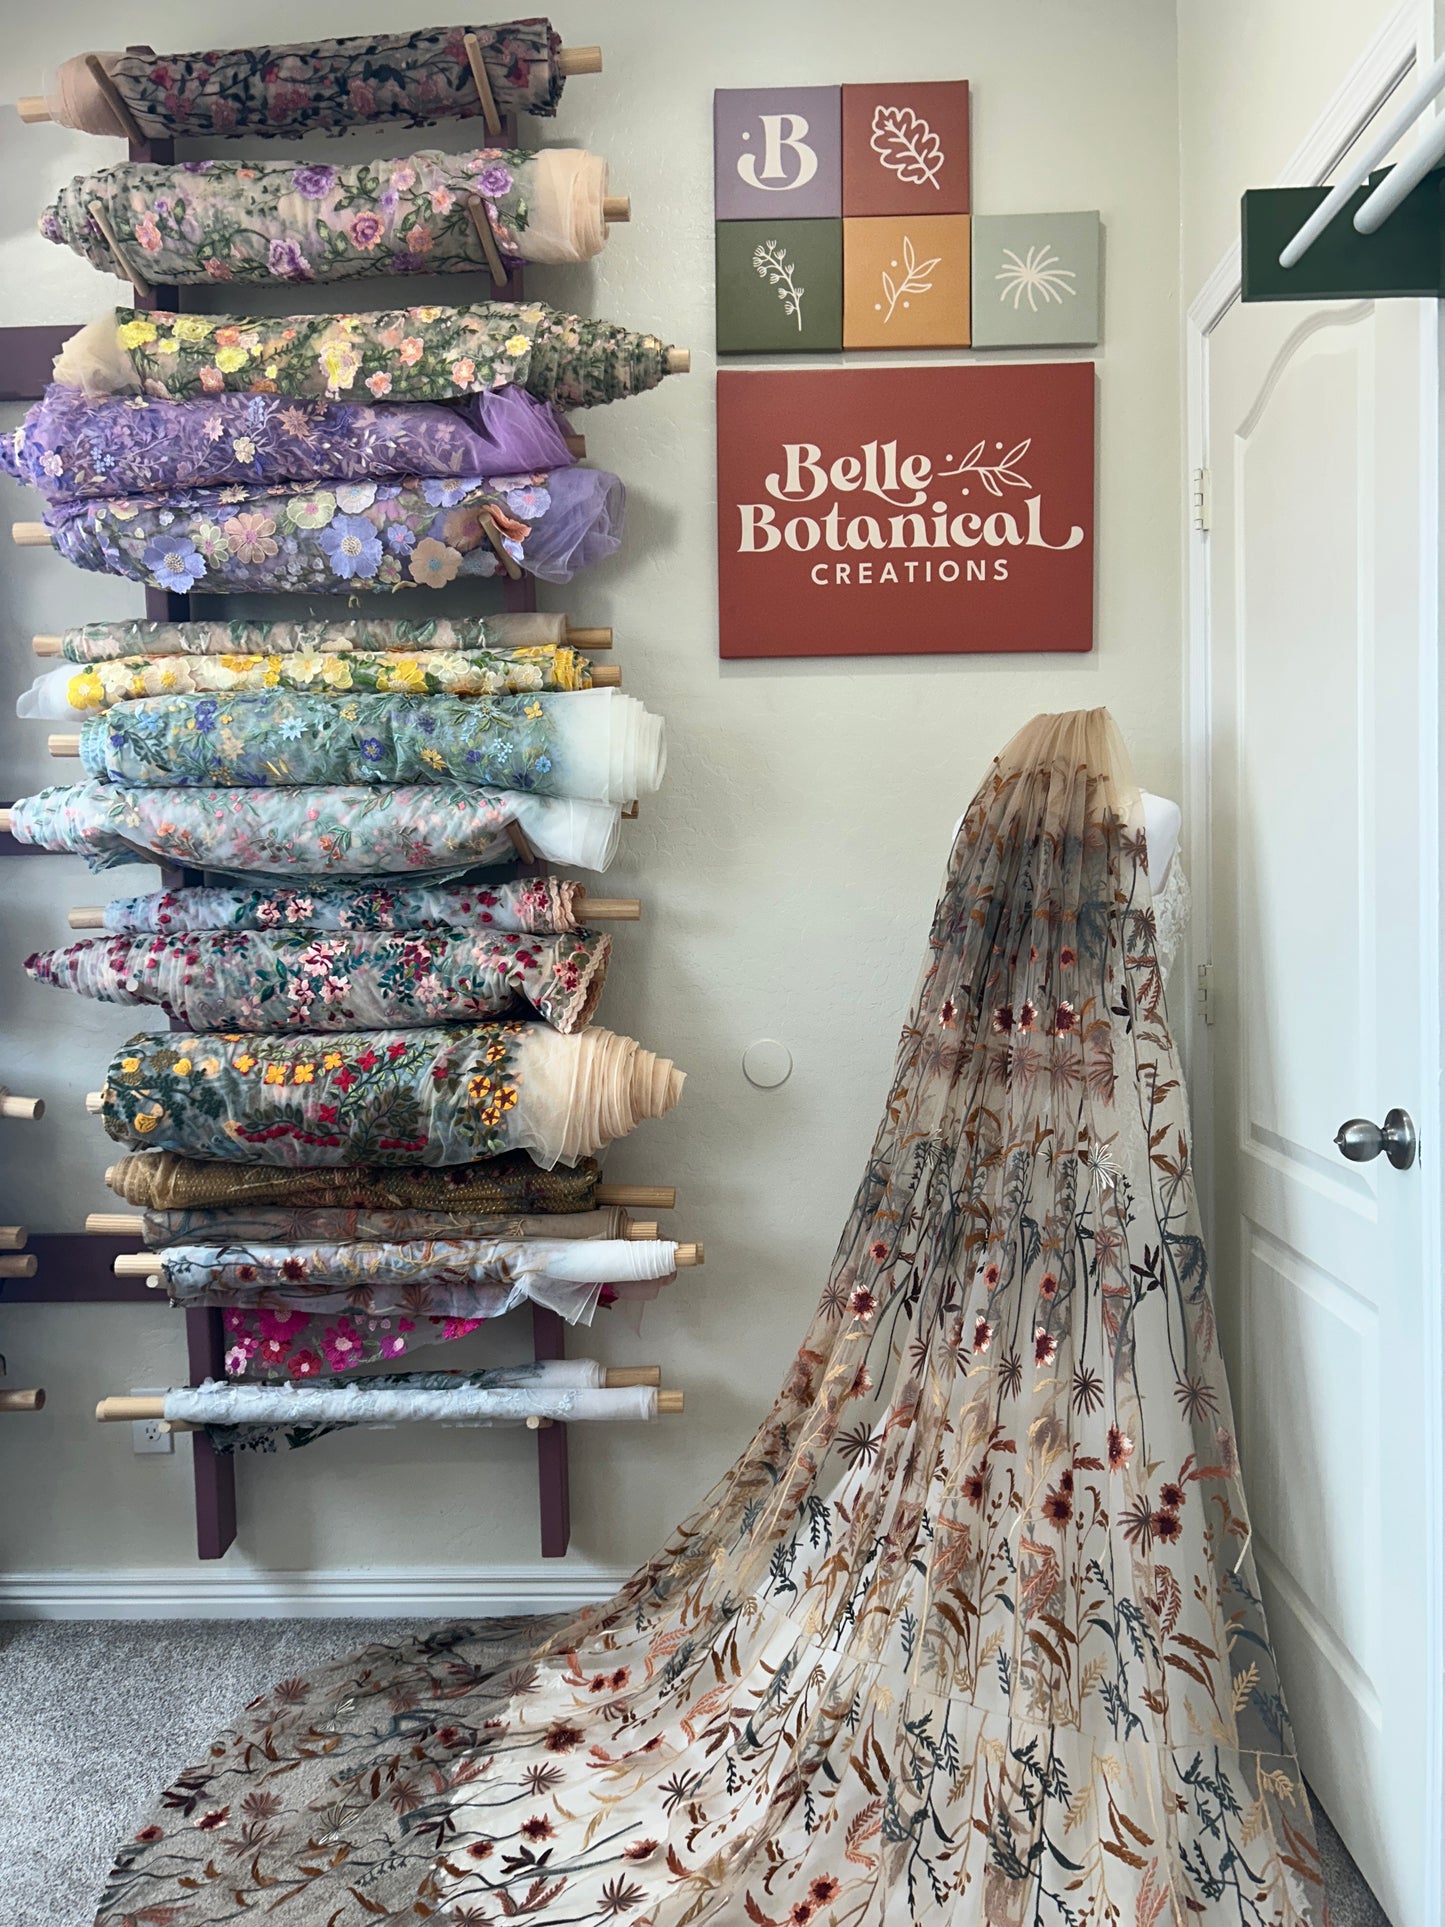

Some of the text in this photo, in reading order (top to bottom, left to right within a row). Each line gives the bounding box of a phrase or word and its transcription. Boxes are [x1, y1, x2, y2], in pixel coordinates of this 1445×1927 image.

[736, 113, 819, 191] B
[765, 439, 933, 507] Belle
[736, 494, 1085, 553] Botanical
[811, 559, 1009, 585] CREATIONS
